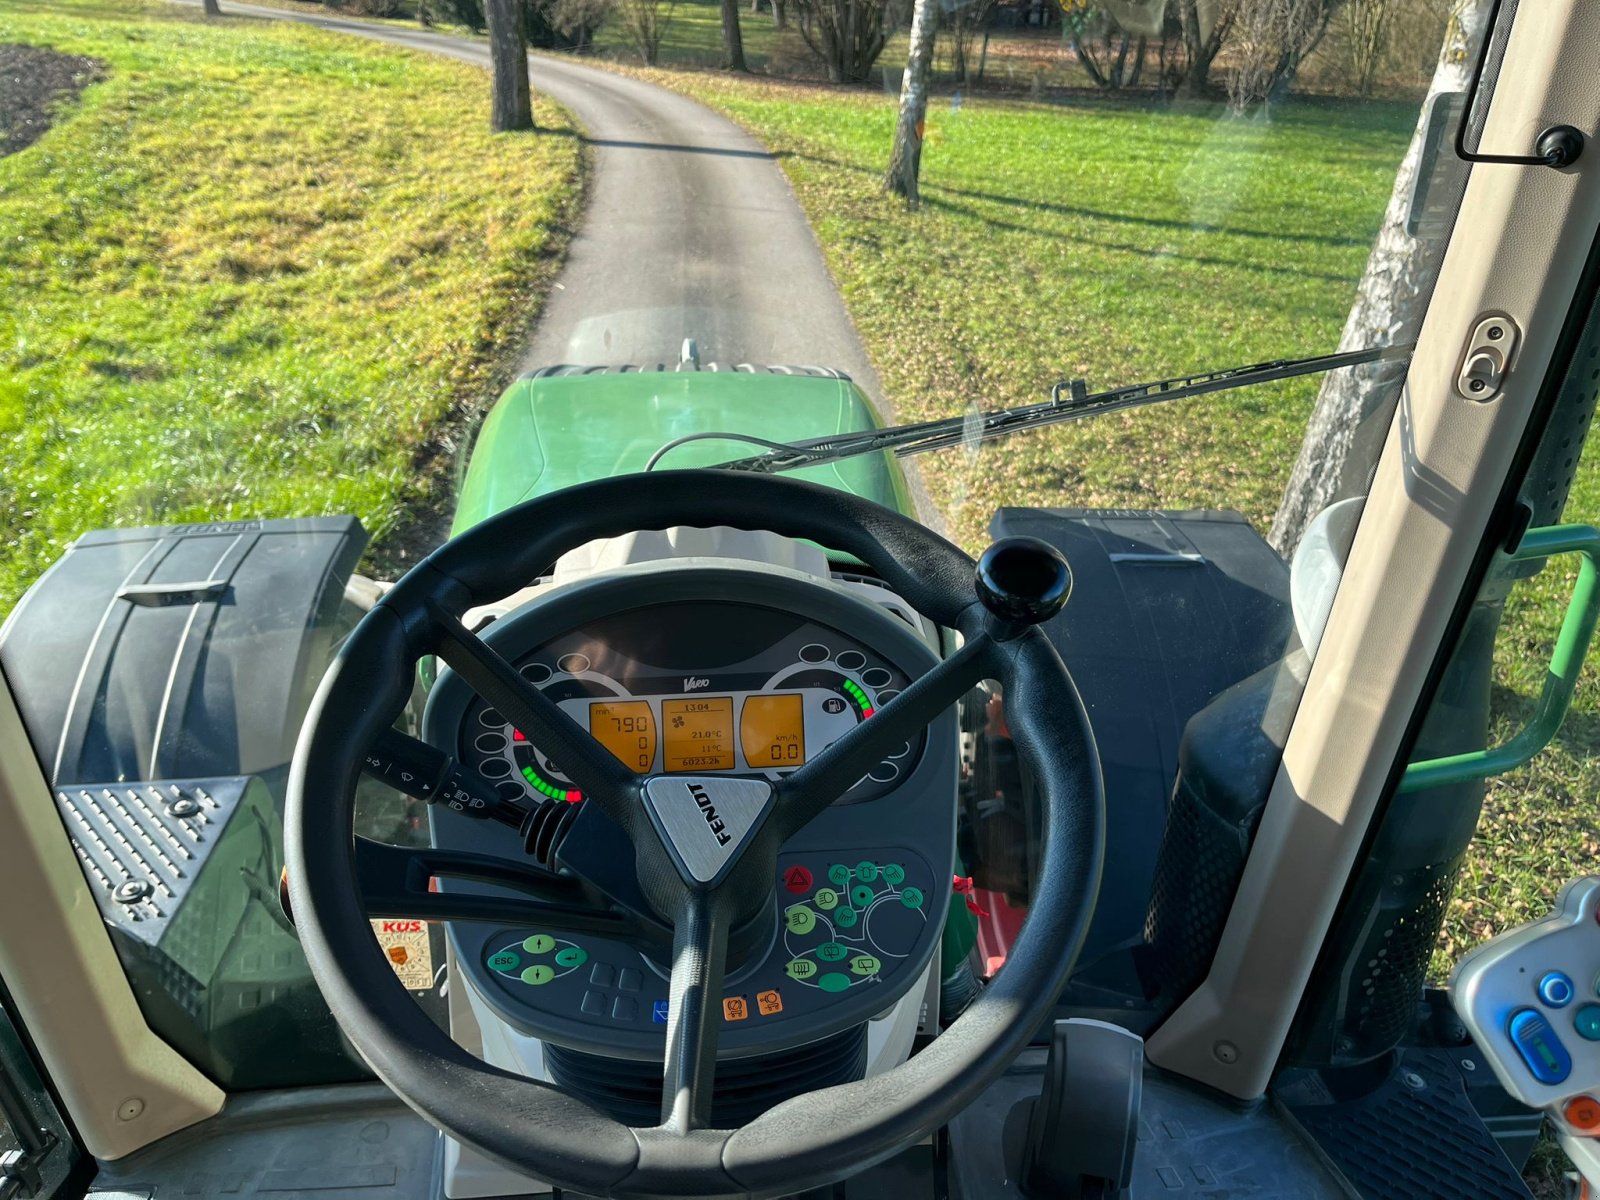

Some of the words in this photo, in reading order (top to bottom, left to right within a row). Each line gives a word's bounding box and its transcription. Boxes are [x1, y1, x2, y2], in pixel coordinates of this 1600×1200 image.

[611, 717, 647, 733] 790
[638, 736, 648, 750] 0
[775, 734, 798, 742] km/h
[770, 744, 798, 760] 0.0
[639, 753, 648, 767] 0
[685, 783, 732, 847] FENDT
[494, 956, 514, 965] ESC
